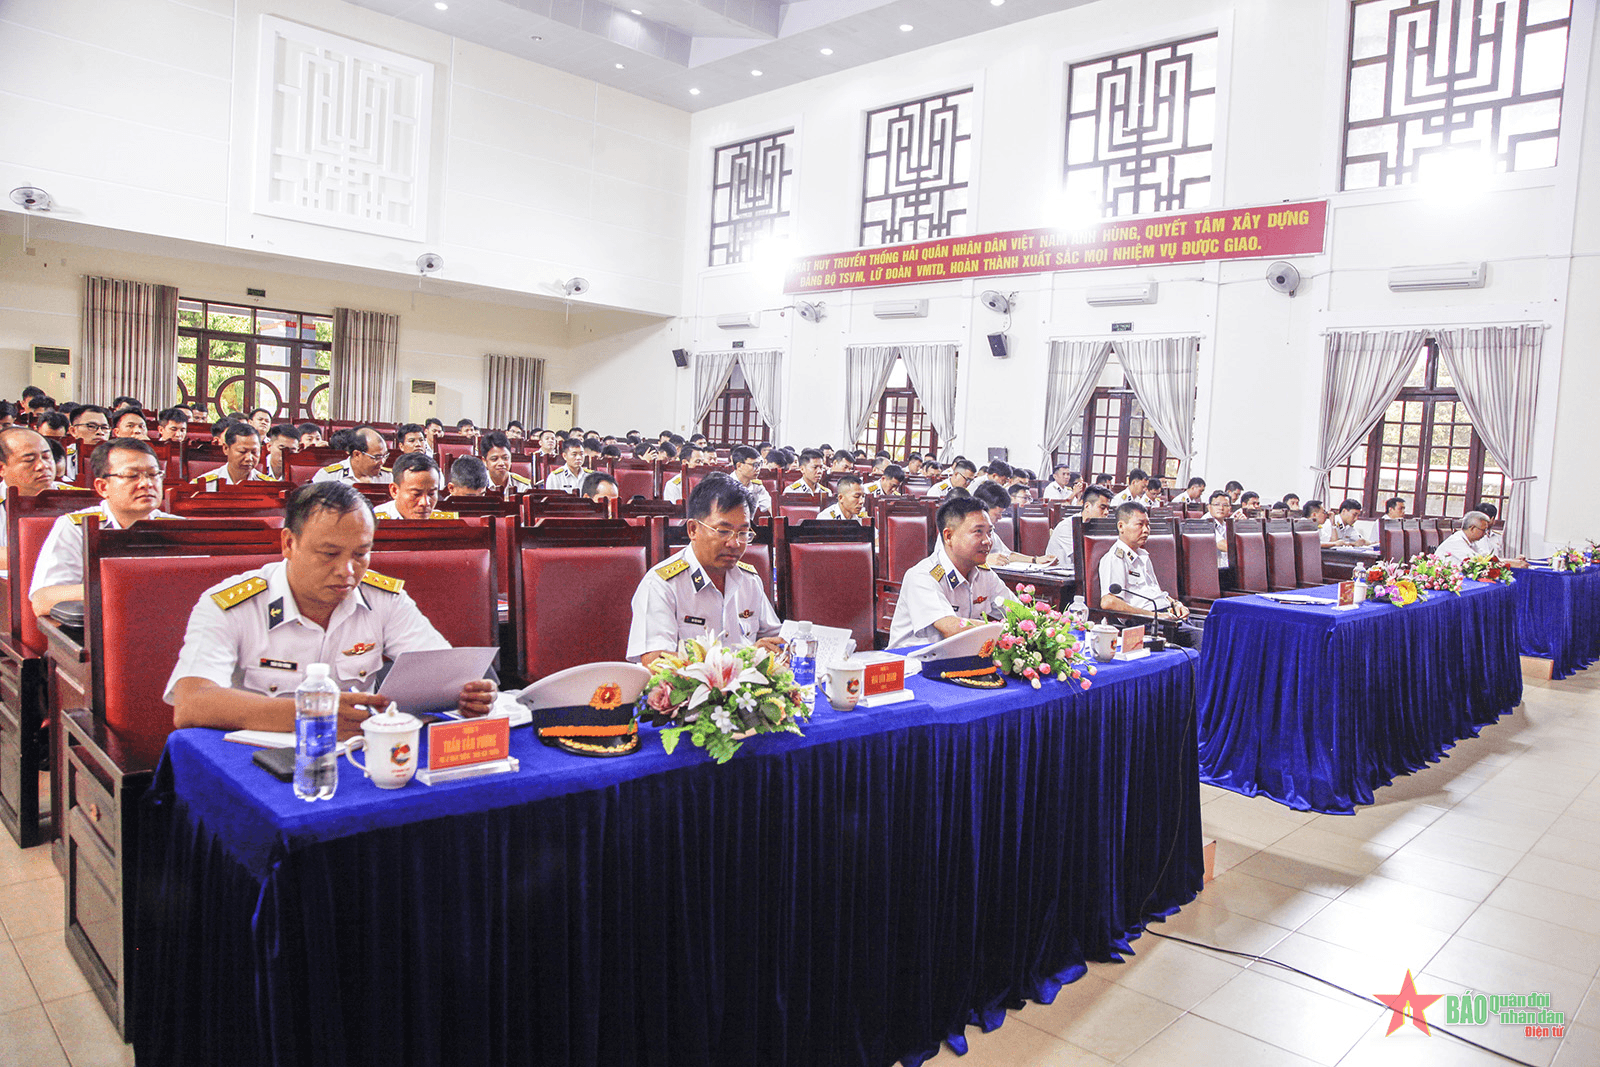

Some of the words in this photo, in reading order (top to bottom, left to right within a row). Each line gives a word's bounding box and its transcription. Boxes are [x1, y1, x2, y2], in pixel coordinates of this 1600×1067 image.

[813, 259, 831, 271] HUY
[869, 249, 899, 266] THỐNG
[902, 245, 919, 262] HẢI
[922, 244, 949, 261] QUÂN
[952, 240, 981, 256] NHÂN
[984, 238, 1007, 254] DÂN
[1011, 234, 1034, 251] VIỆT
[1039, 232, 1067, 248] NAM
[1071, 230, 1096, 246] ANH
[1102, 225, 1140, 242] HÙNG,
[1145, 218, 1187, 240] QUYẾT
[1194, 216, 1226, 235] TÂM
[1232, 212, 1261, 231] XÂY
[1267, 209, 1309, 231] DỰNG
[824, 271, 837, 286] BỘ
[839, 271, 865, 284] TSVM,
[885, 263, 911, 280] ĐOÀN
[916, 263, 946, 278] VMTD,
[950, 256, 979, 275] HOÀN
[983, 254, 1019, 271] THÀNH
[1022, 249, 1052, 268] XUẤT
[1084, 247, 1108, 264] MỌI
[1113, 243, 1155, 262] NHIỆM
[1159, 242, 1178, 259] VỤ
[1181, 237, 1219, 256] ĐƯỢC
[1224, 236, 1262, 253] GIAO.
